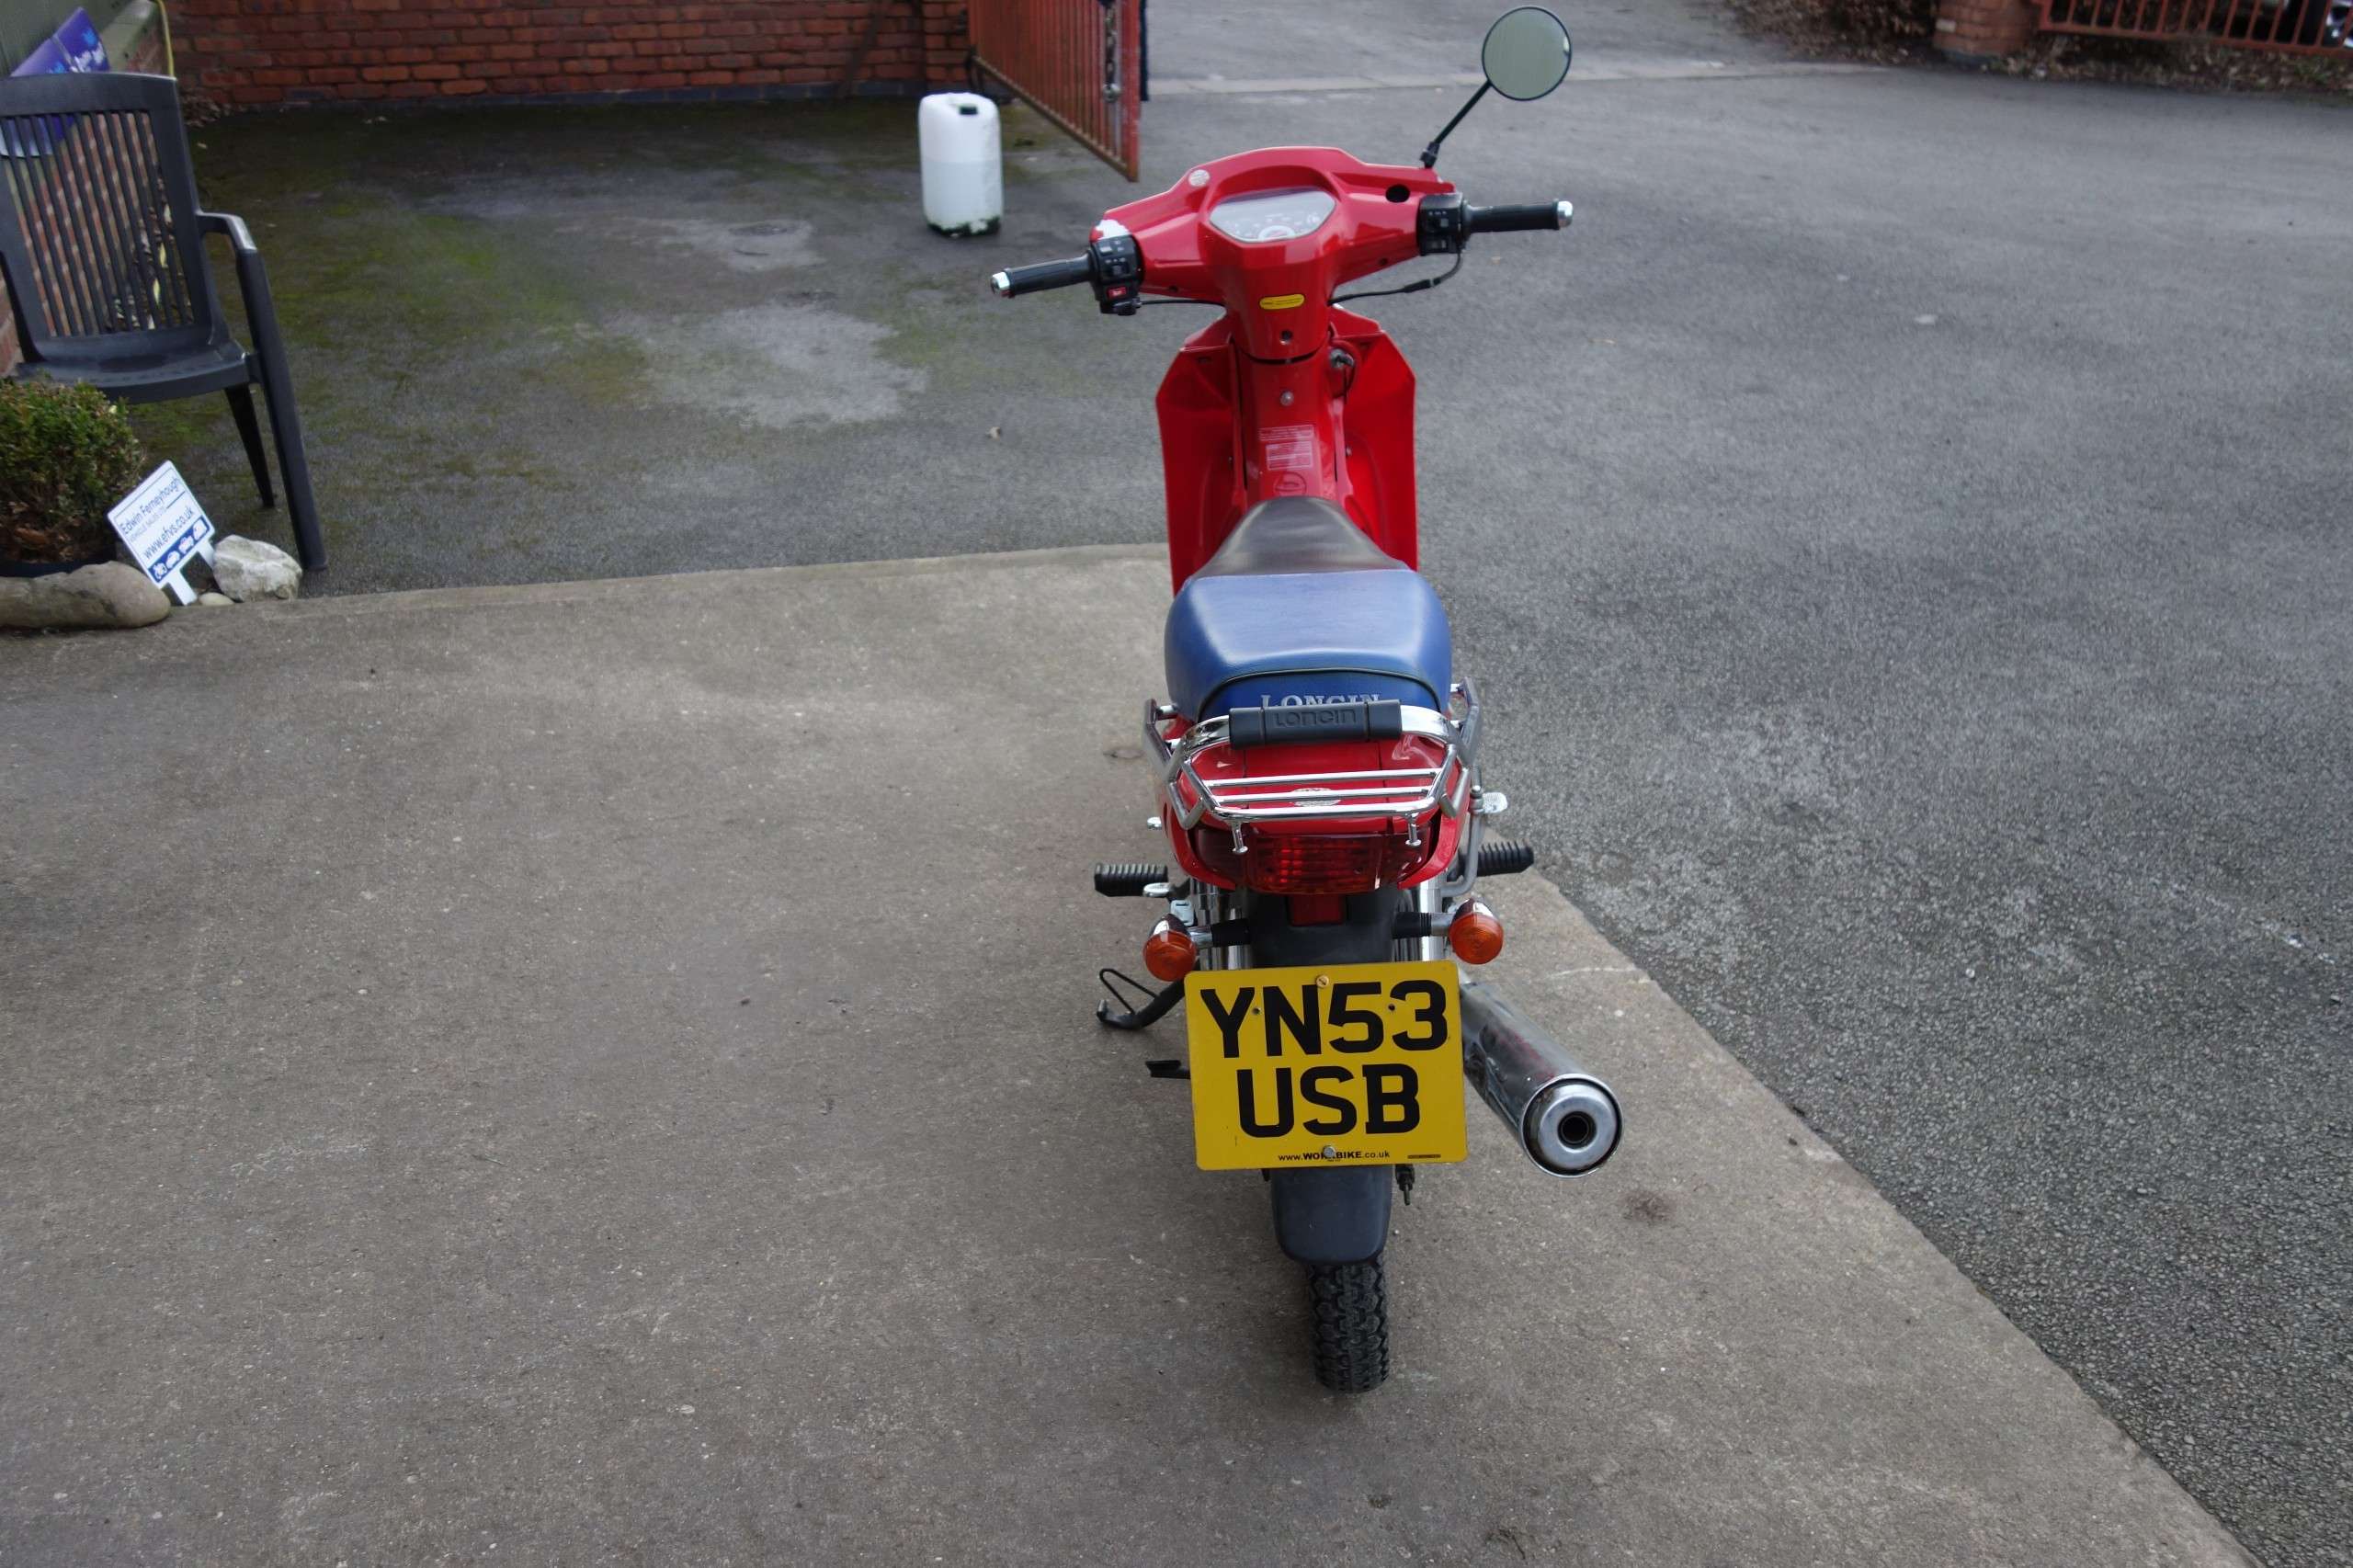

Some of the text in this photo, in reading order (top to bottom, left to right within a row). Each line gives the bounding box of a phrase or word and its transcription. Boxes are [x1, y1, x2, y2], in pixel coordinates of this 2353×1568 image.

[119, 513, 142, 534] Edwin
[1199, 980, 1449, 1059] YN53
[1236, 1062, 1421, 1138] USB
[1278, 1150, 1391, 1162] www.WOBIKE.co.uk
